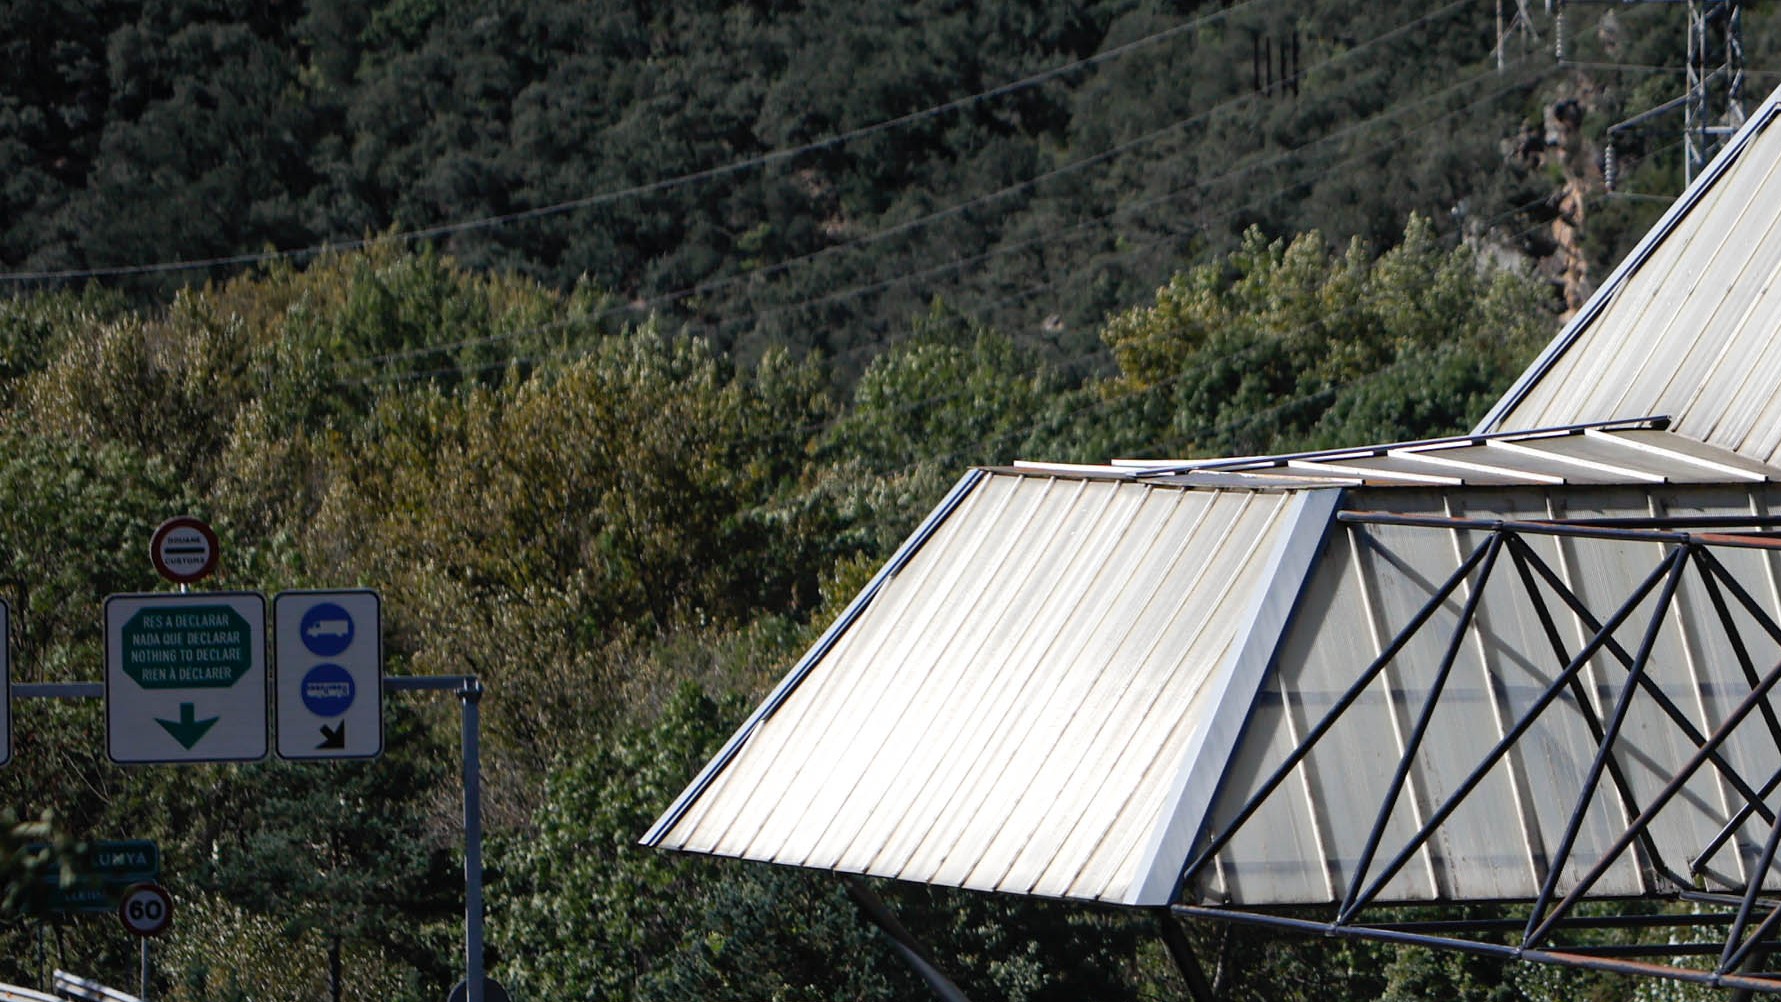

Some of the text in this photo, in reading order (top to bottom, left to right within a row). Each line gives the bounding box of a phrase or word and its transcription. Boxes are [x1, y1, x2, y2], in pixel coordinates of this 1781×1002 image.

[143, 613, 229, 629] RES A DECLARAR
[132, 630, 240, 646] NADA QUE DECLARAR
[131, 647, 241, 663] NOTHING TO DECLARE
[142, 667, 166, 681] RIEN
[129, 900, 162, 920] 60
